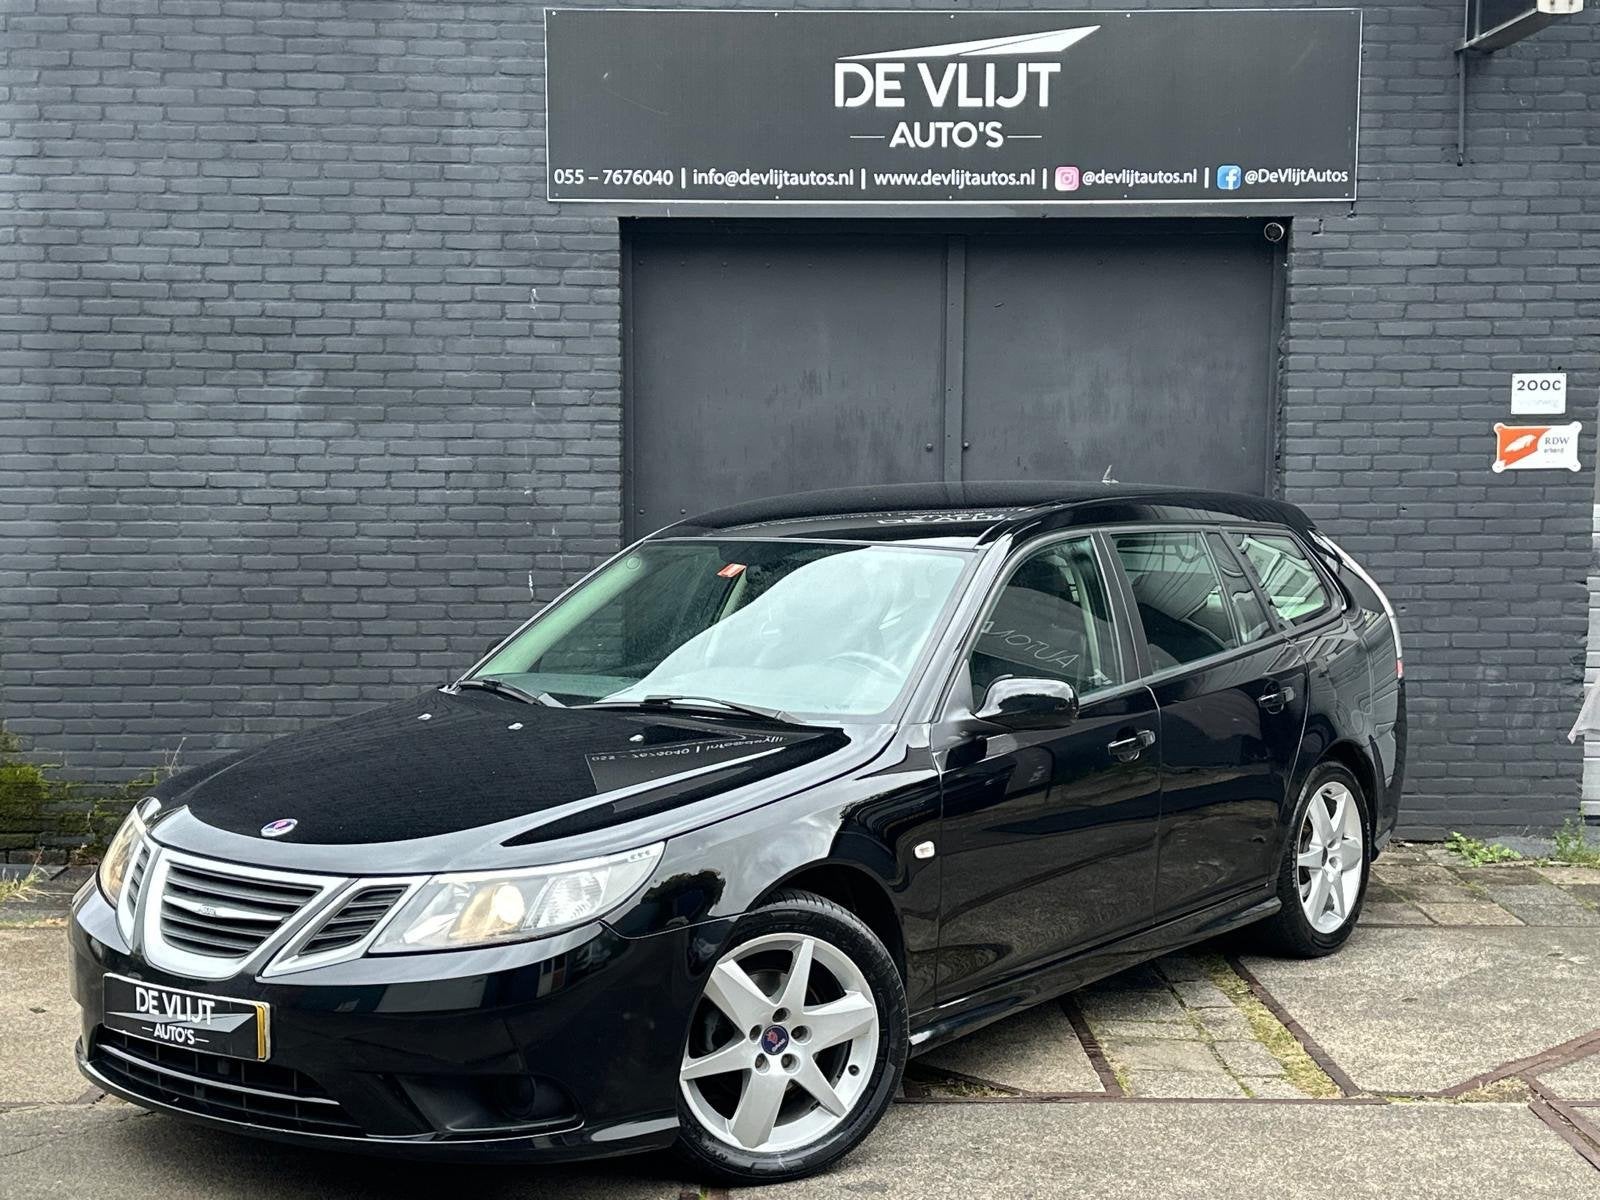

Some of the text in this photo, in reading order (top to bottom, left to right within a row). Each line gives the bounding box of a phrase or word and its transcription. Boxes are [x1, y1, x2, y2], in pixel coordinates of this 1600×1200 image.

[834, 62, 1062, 109] DE VLIJT
[888, 121, 1004, 149] AUTO'S
[553, 168, 585, 186] 055
[602, 169, 674, 186] 7676040
[692, 167, 854, 190] info@devlijtautos.nl
[873, 168, 1036, 190] www.devlijtautos.nl
[1082, 168, 1198, 190] @devlijtautos.nl
[1244, 167, 1349, 187] @DeVlijtAutos
[1544, 436, 1570, 446] RDW
[135, 986, 216, 1026] DE VLIJT
[153, 1023, 196, 1046] AUTO'S
